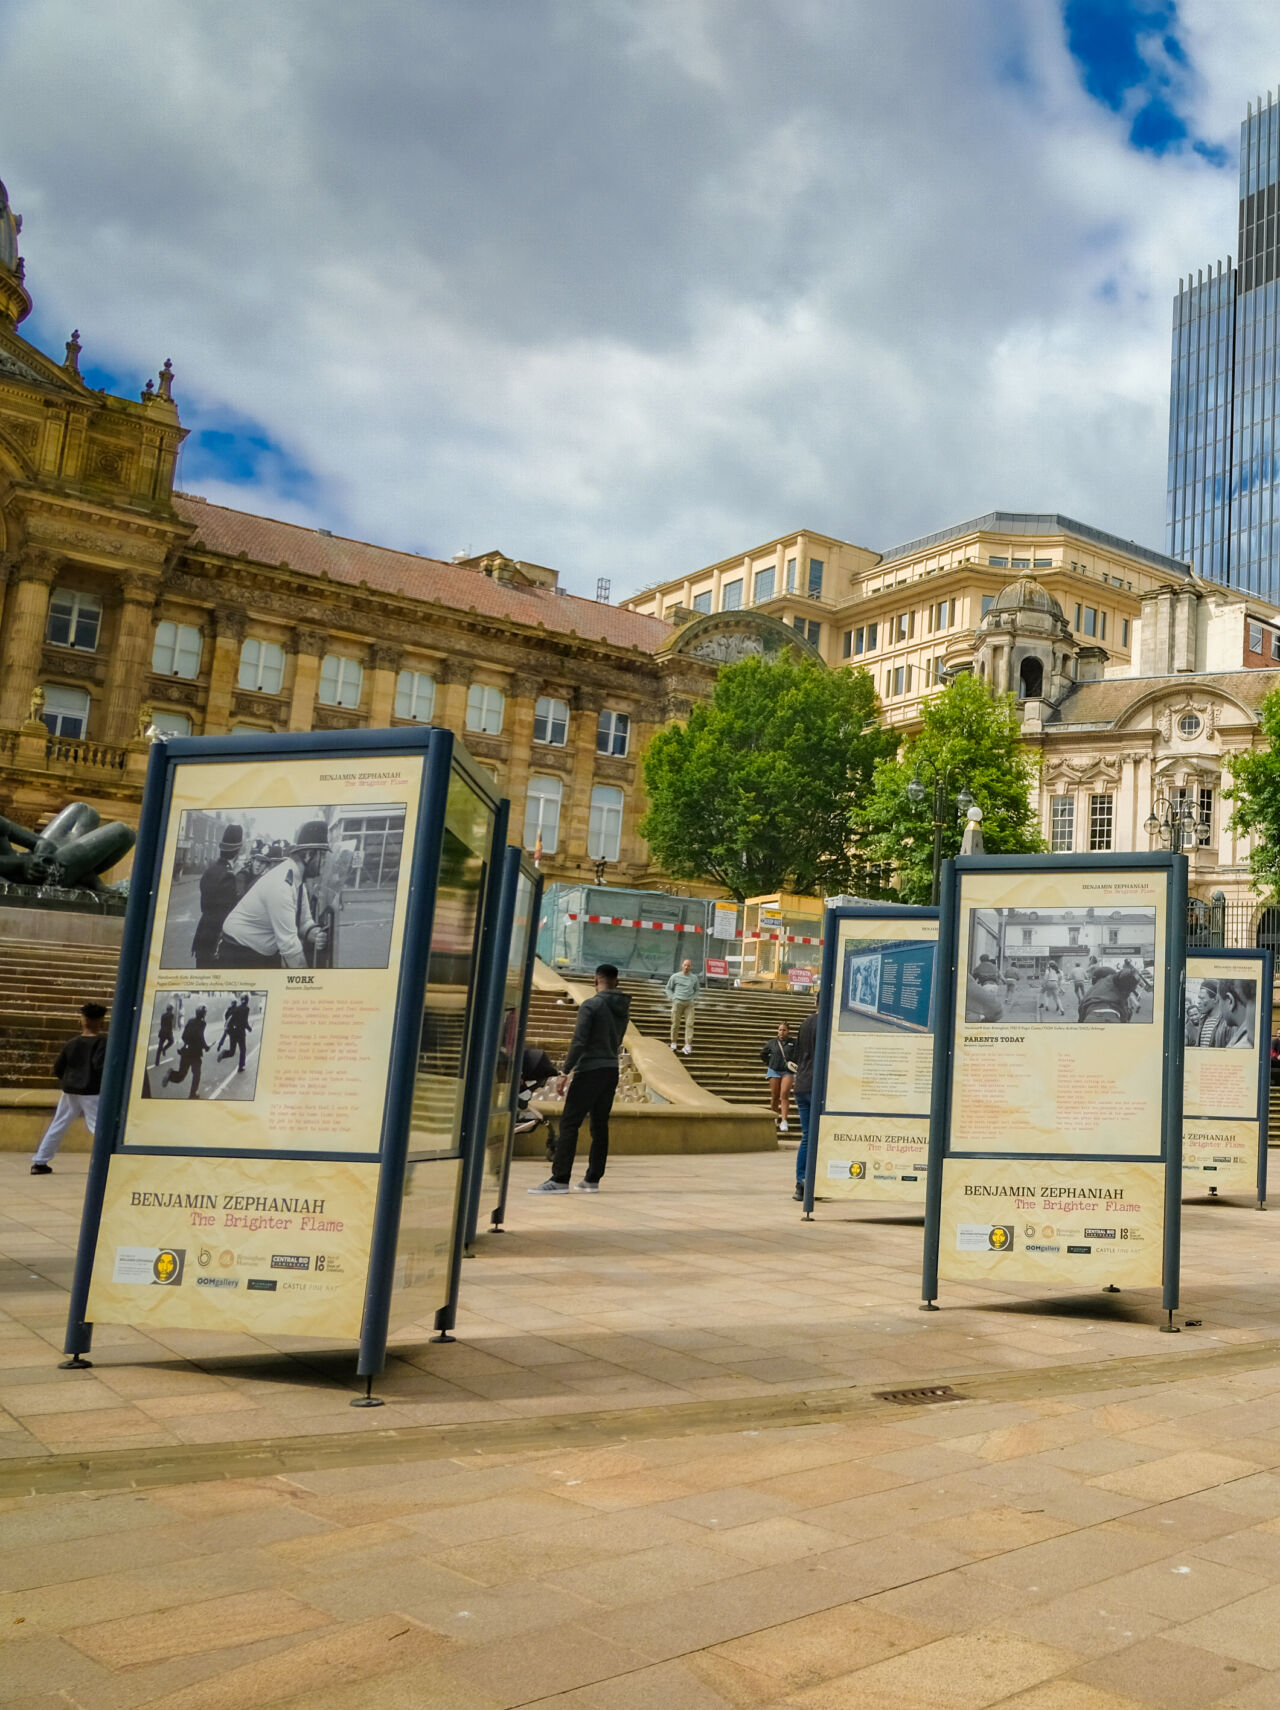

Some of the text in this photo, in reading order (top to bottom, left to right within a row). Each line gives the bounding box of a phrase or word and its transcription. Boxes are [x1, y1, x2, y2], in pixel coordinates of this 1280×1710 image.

[788, 968, 811, 977] FOOTPATH
[287, 976, 315, 984] WORK
[792, 975, 810, 983] CLOSED
[833, 1133, 929, 1146] BENJAMIN ZEPHANI
[1188, 1133, 1236, 1142] ZEPHANIAH
[867, 1143, 925, 1154] The Brighter
[964, 1185, 1124, 1200] BENJAMIN ZEPHANIAH
[130, 1192, 326, 1215] BENJAMIN ZEPHANIAH
[1014, 1199, 1141, 1213] The Brighter Flame
[190, 1211, 344, 1233] The Brighter Flame
[197, 1277, 239, 1289] OOMgallery
